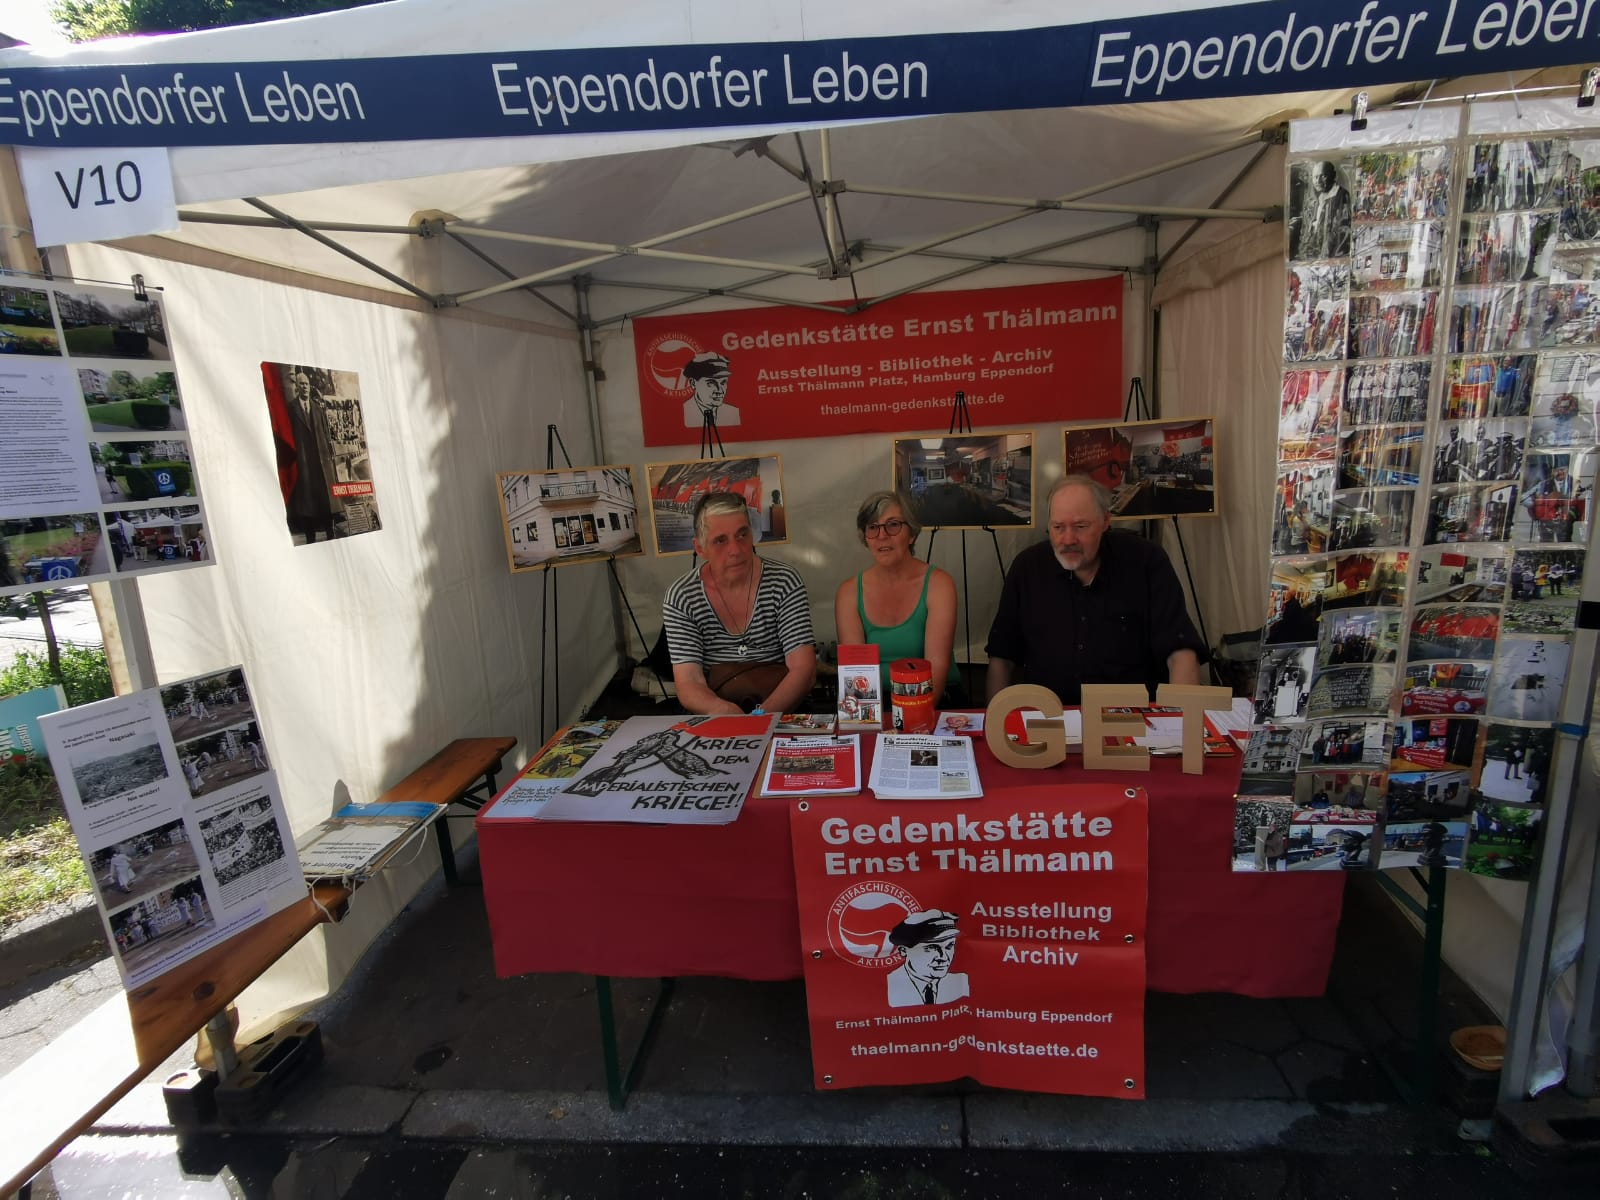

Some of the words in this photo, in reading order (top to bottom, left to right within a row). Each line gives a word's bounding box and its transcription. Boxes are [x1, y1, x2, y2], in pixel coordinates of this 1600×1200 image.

[1090, 1, 1429, 97] Eppendorfer
[0, 72, 226, 138] Eppendorfer
[234, 71, 366, 123] Leben
[491, 55, 769, 126] Eppendorfer
[784, 51, 928, 105] Leben
[54, 161, 142, 209] V10
[722, 323, 894, 351] Gedenkstätte
[904, 314, 974, 337] Ernst
[983, 305, 1117, 330] Thälmann
[757, 364, 862, 381] Ausstellung
[879, 353, 973, 372] Bibliothek
[992, 347, 1053, 364] Archiv
[758, 382, 794, 395] Ernst
[798, 378, 865, 392] Thälmann
[869, 376, 908, 387] Platz,
[912, 370, 976, 384] Hamburg
[980, 363, 1054, 380] Eppendorf
[985, 683, 1233, 775] GET
[712, 755, 750, 765] DEM
[821, 811, 1112, 845] Gedenkstätte
[824, 851, 920, 875] Ernst
[932, 848, 1113, 873] Thälmann
[832, 882, 919, 915] ANTIFASCHISTISCHE
[971, 902, 1112, 922] Ausstellung
[982, 924, 1100, 940] Bibliothek
[857, 954, 902, 967] AKTION
[1002, 945, 1078, 965] Archiv
[835, 1019, 870, 1029] Ernst
[874, 1012, 938, 1026] Thälmann
[941, 1005, 972, 1020] Platz,
[976, 1008, 1037, 1022] Hamburg
[1041, 1010, 1113, 1023] Eppendorf
[850, 1034, 1098, 1058] thaelmann-gedenkstaette.de
